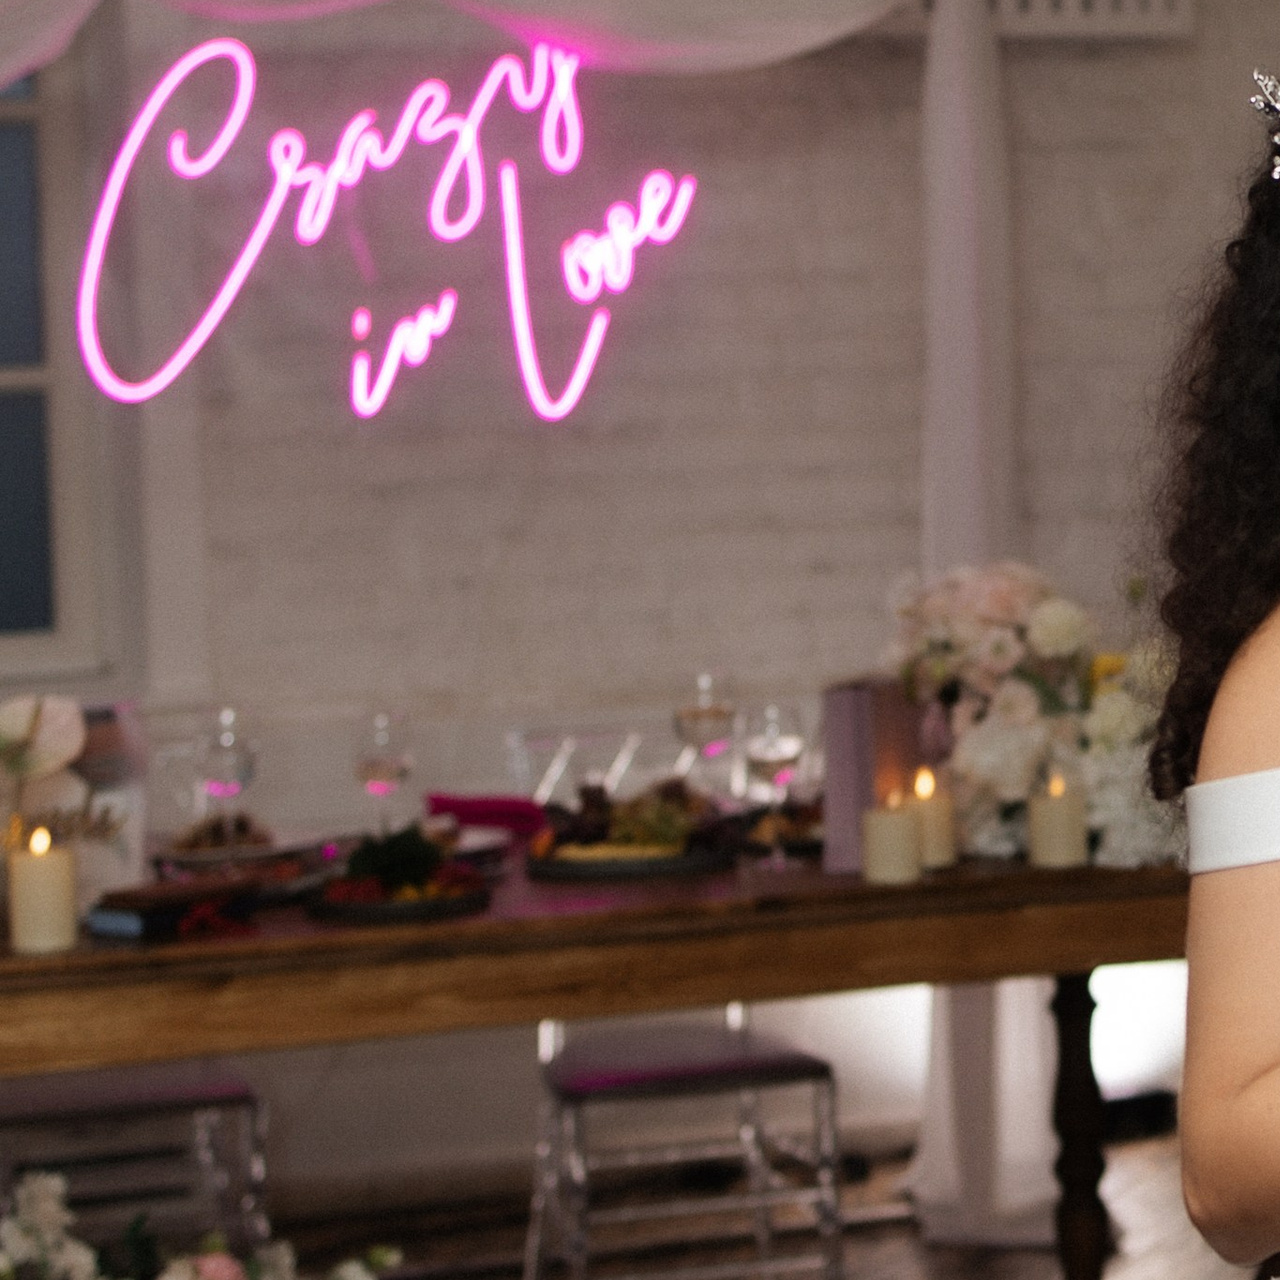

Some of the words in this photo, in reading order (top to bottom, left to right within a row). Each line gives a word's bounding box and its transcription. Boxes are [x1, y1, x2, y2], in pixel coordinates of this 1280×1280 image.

[77, 37, 584, 404] Crazy
[350, 287, 459, 419] in
[498, 157, 699, 422] Love
